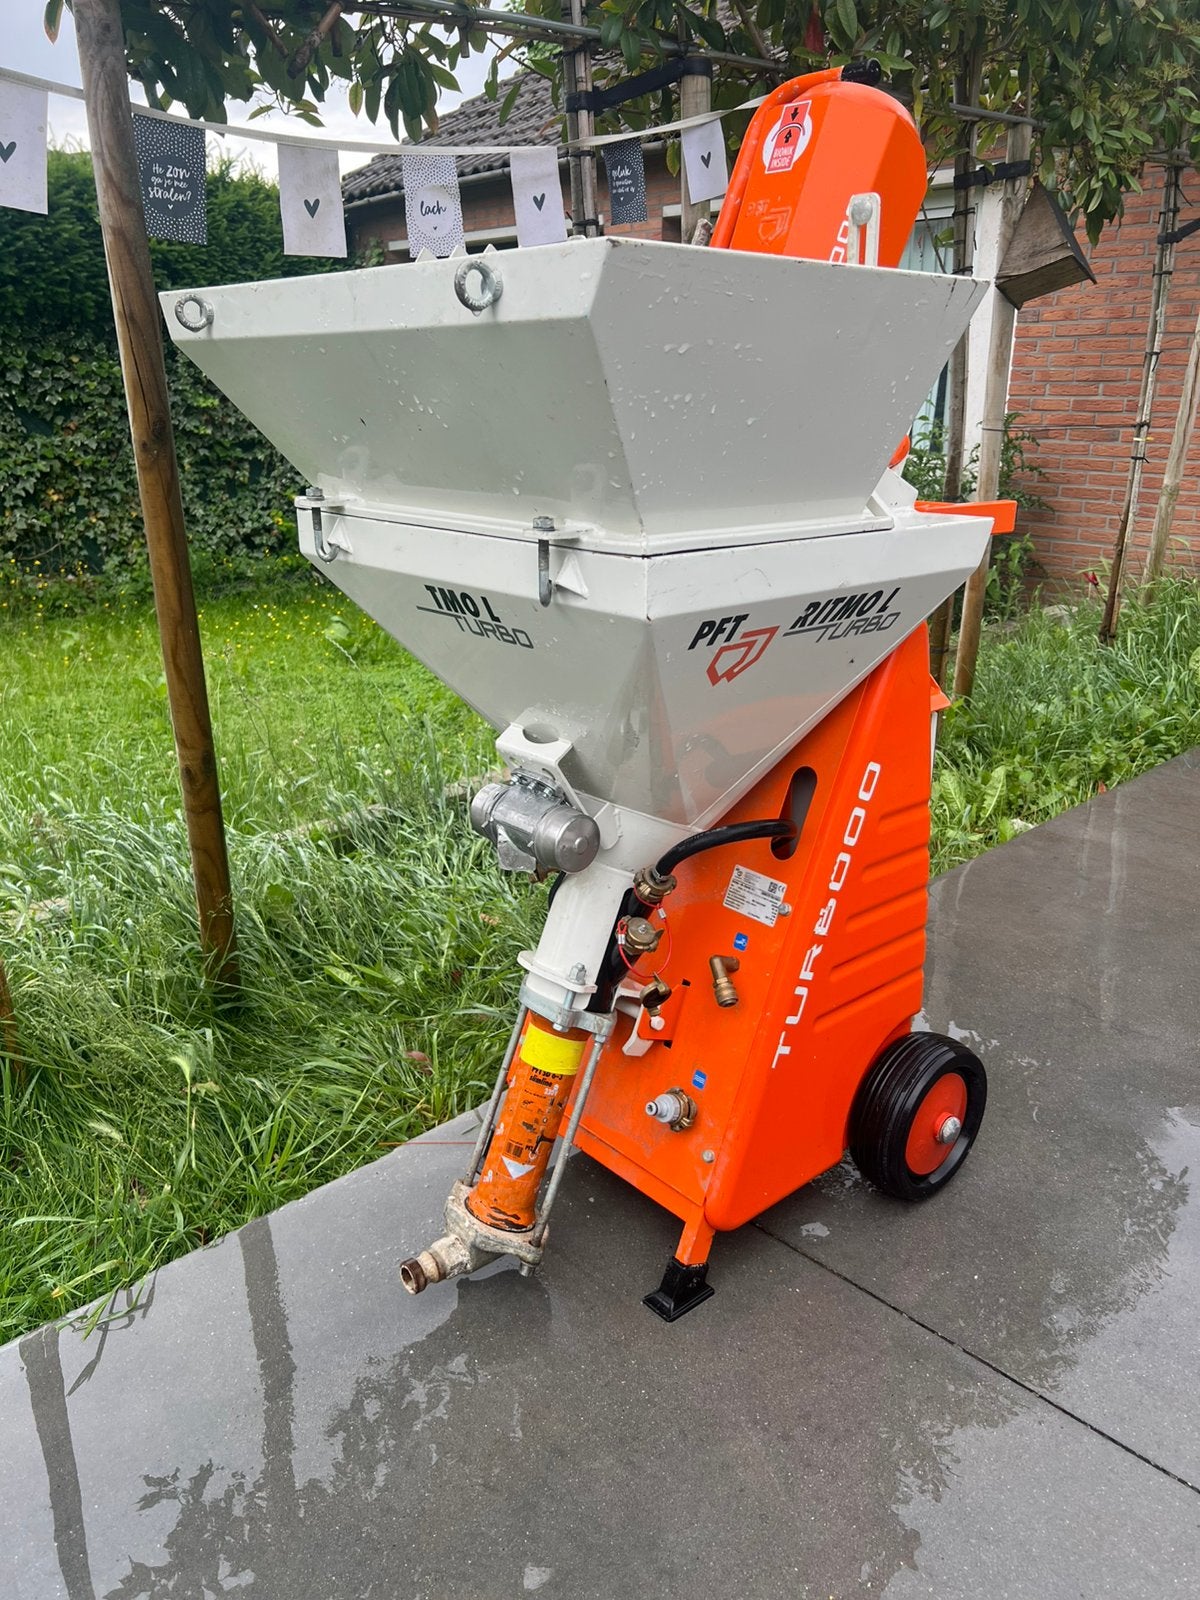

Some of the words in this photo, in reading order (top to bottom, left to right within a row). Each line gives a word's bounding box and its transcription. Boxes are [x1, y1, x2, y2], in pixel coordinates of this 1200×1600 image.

[148, 186, 192, 203] stralen?
[424, 584, 480, 618] TMO
[790, 590, 883, 630] RITMO
[416, 605, 534, 649] TURBO
[687, 613, 750, 651] PFT
[782, 612, 901, 643] TURBO
